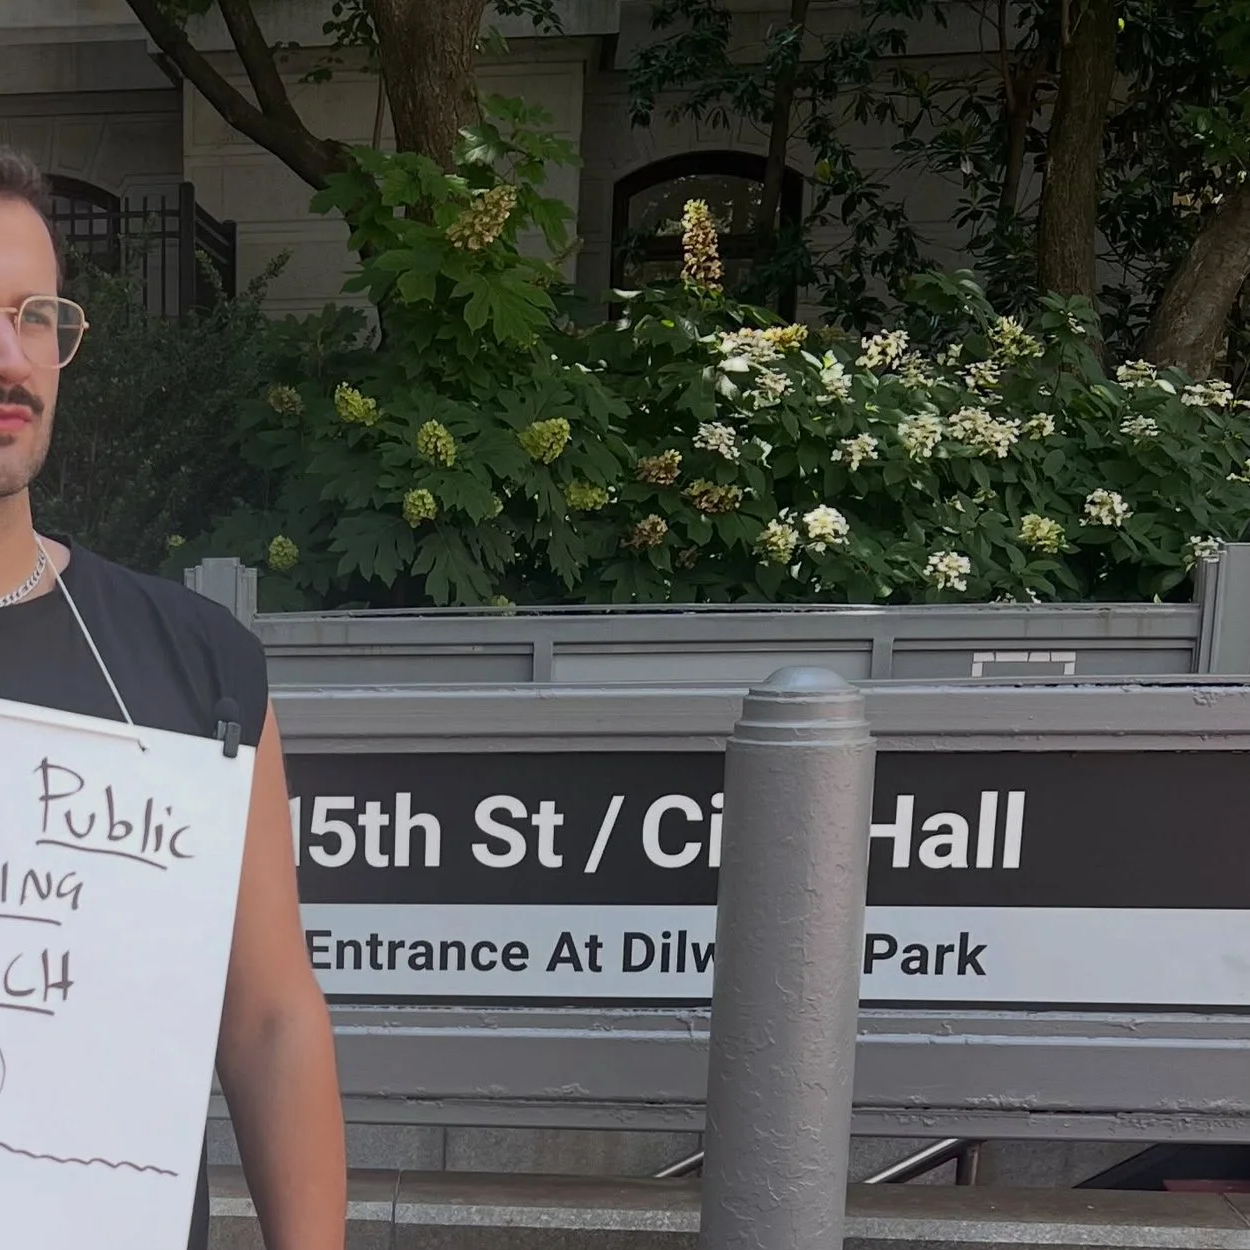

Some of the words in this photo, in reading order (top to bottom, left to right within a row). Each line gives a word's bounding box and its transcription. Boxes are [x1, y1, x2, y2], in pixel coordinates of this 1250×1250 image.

[34, 757, 195, 859] Public
[471, 794, 564, 868] St
[583, 795, 626, 873] /
[642, 792, 724, 868] Ci
[869, 791, 1025, 869] Hall
[305, 930, 529, 972] Entrance
[545, 931, 603, 972] At
[622, 930, 716, 973] Dilw
[863, 932, 988, 976] Park
